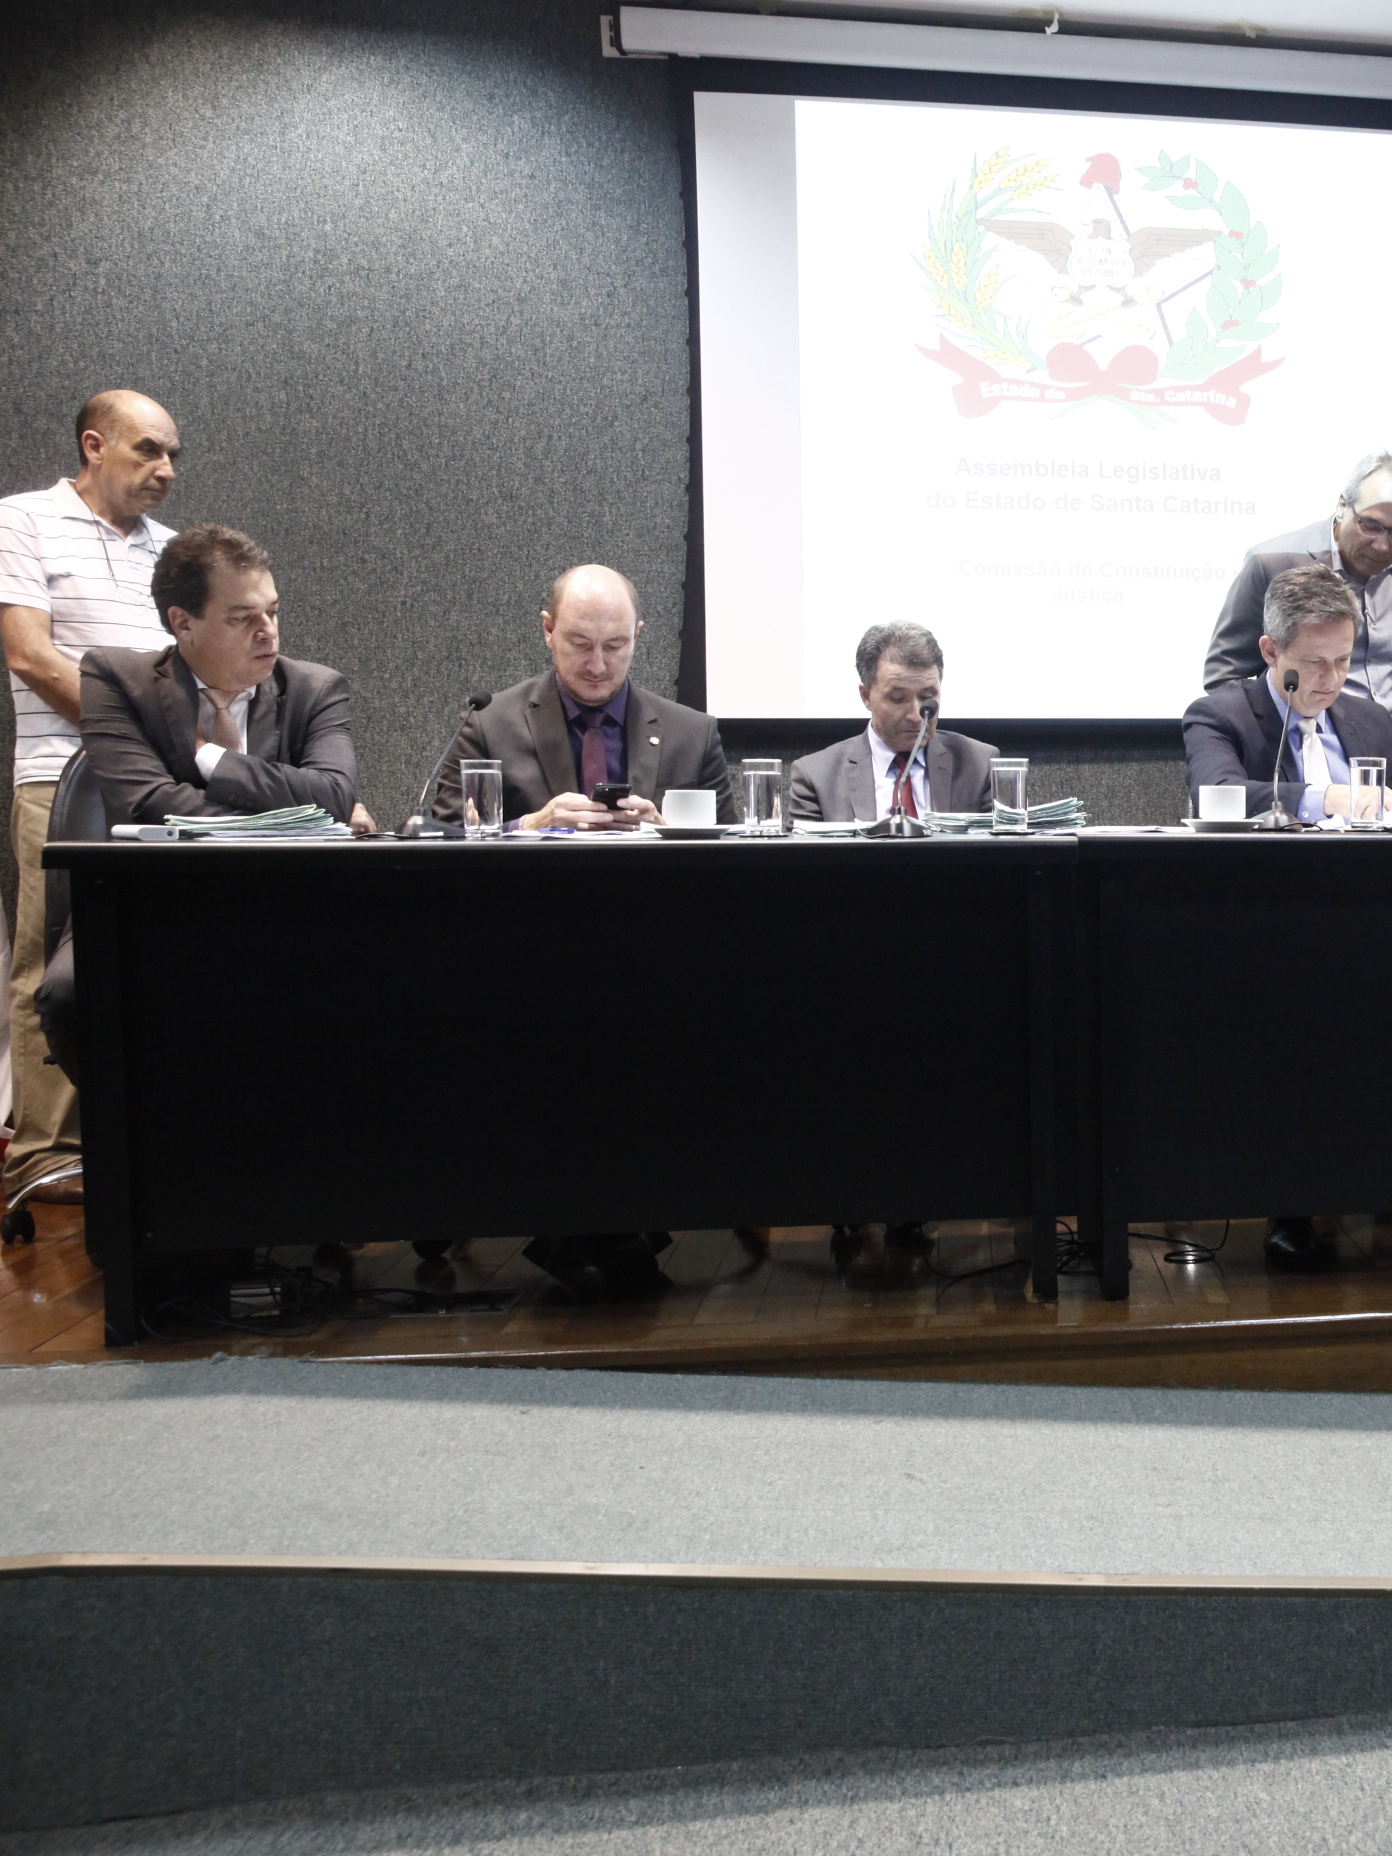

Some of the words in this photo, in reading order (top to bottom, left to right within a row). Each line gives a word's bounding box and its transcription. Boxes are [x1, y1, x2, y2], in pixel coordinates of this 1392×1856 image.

[980, 381, 1041, 399] Estado
[1044, 387, 1066, 400] de
[1128, 390, 1160, 402] Sta.
[1164, 389, 1237, 409] Catarina
[954, 457, 1090, 479] Assembleia
[1098, 460, 1222, 484] Legislativa
[926, 490, 957, 510] do
[964, 490, 1046, 511] Estado
[1054, 492, 1082, 511] de
[1090, 493, 1154, 513] Santa
[1162, 495, 1257, 515] Catarina
[958, 559, 1061, 578] Comissão
[1068, 560, 1093, 578] de
[1100, 562, 1227, 584] Constituição
[1051, 585, 1125, 607] Justiça
